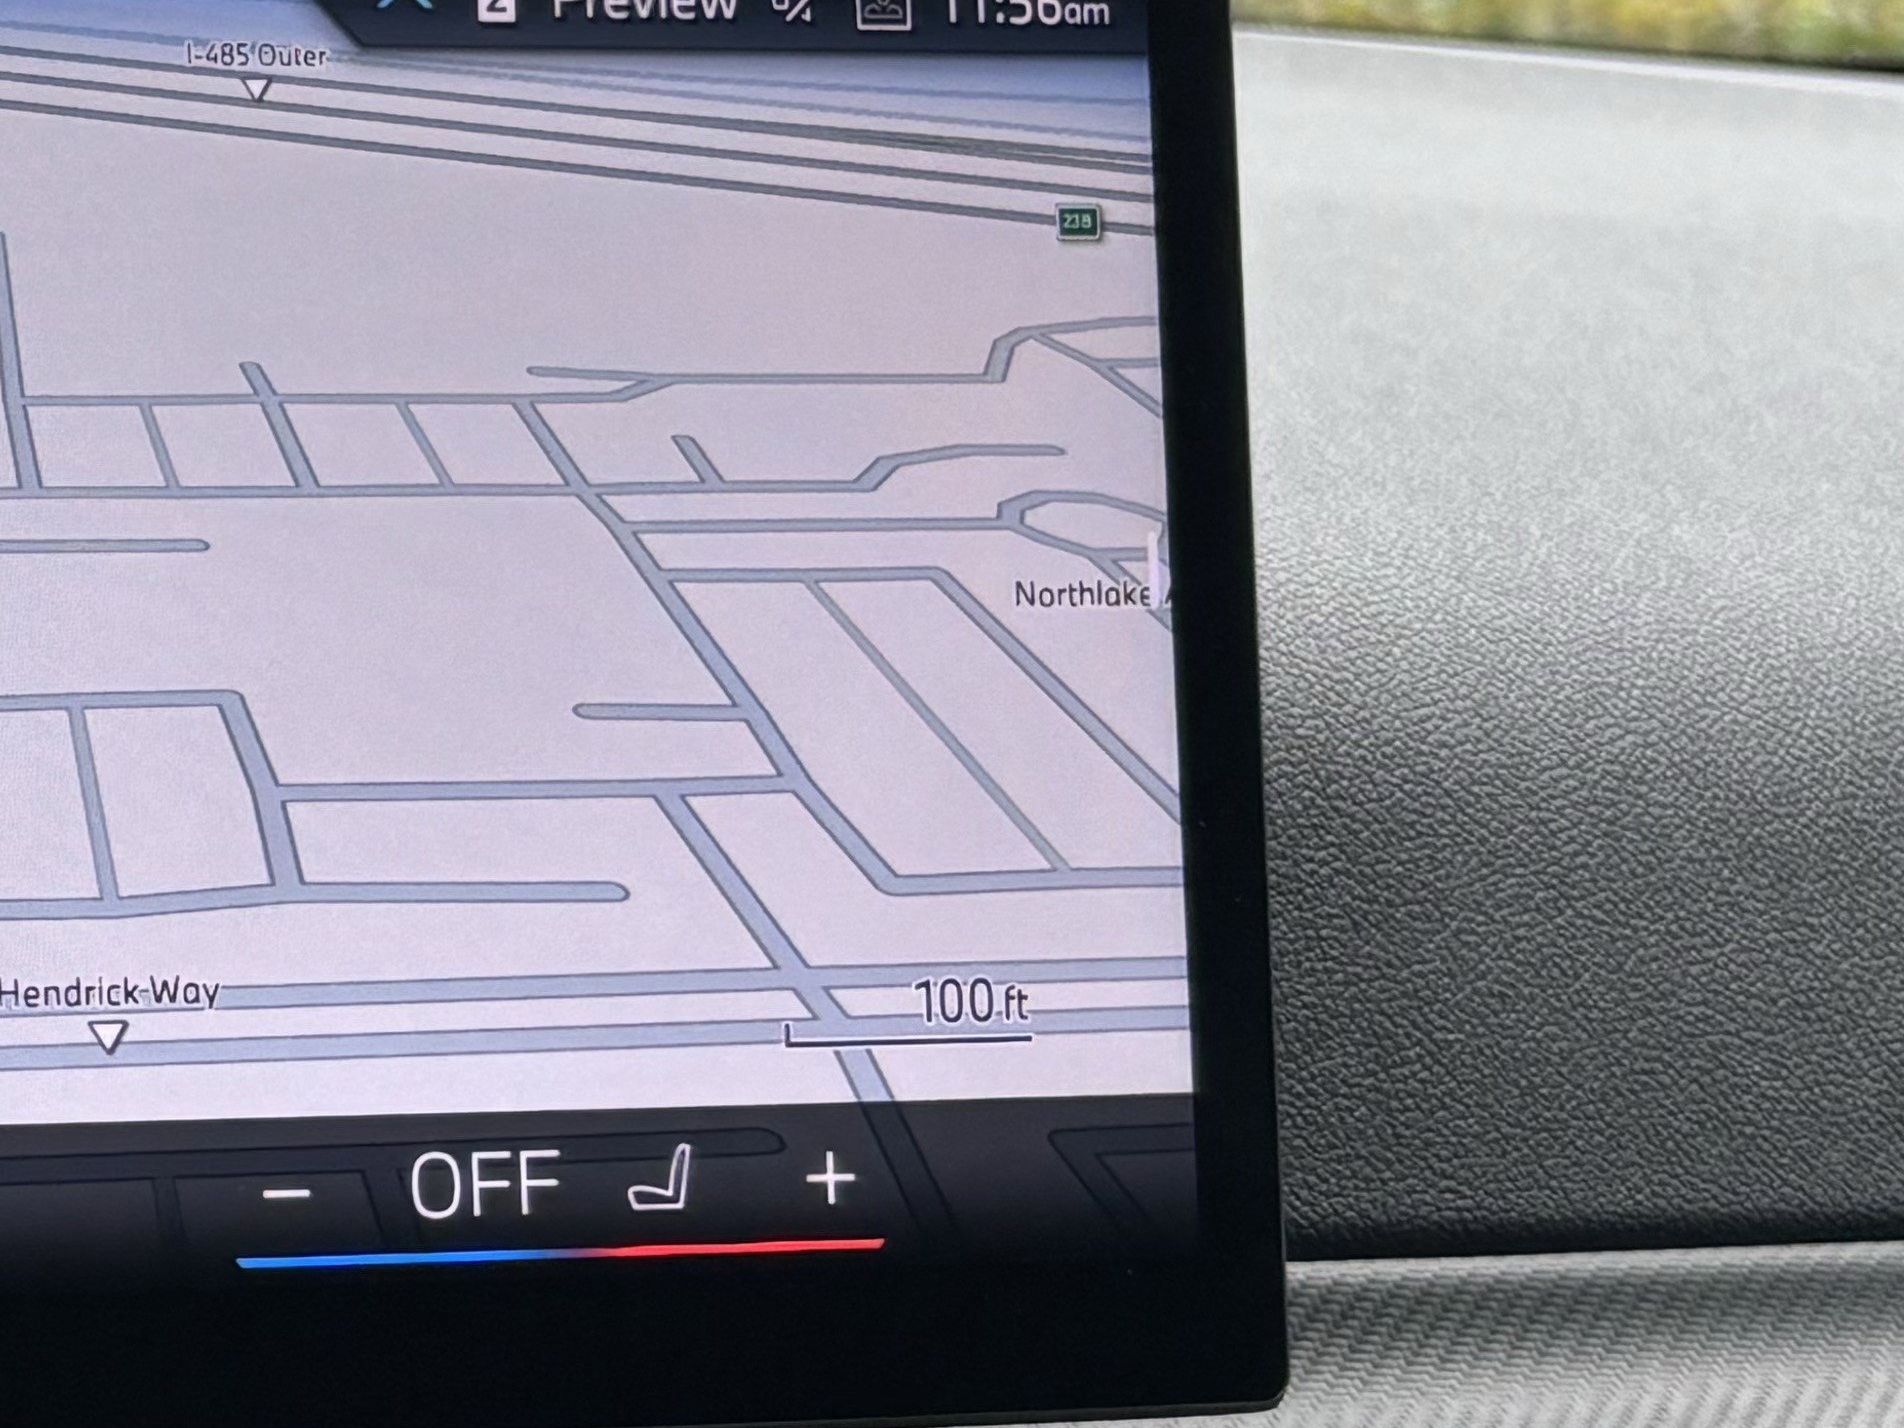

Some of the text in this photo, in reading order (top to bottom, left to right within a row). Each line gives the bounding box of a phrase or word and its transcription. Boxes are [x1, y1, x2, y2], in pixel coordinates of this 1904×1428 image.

[187, 42, 327, 68] I-485 Outer
[1015, 579, 1150, 608] Northlake
[149, 975, 220, 1014] Way
[914, 978, 1031, 1024] 100 ft
[411, 1149, 561, 1220] OFF
